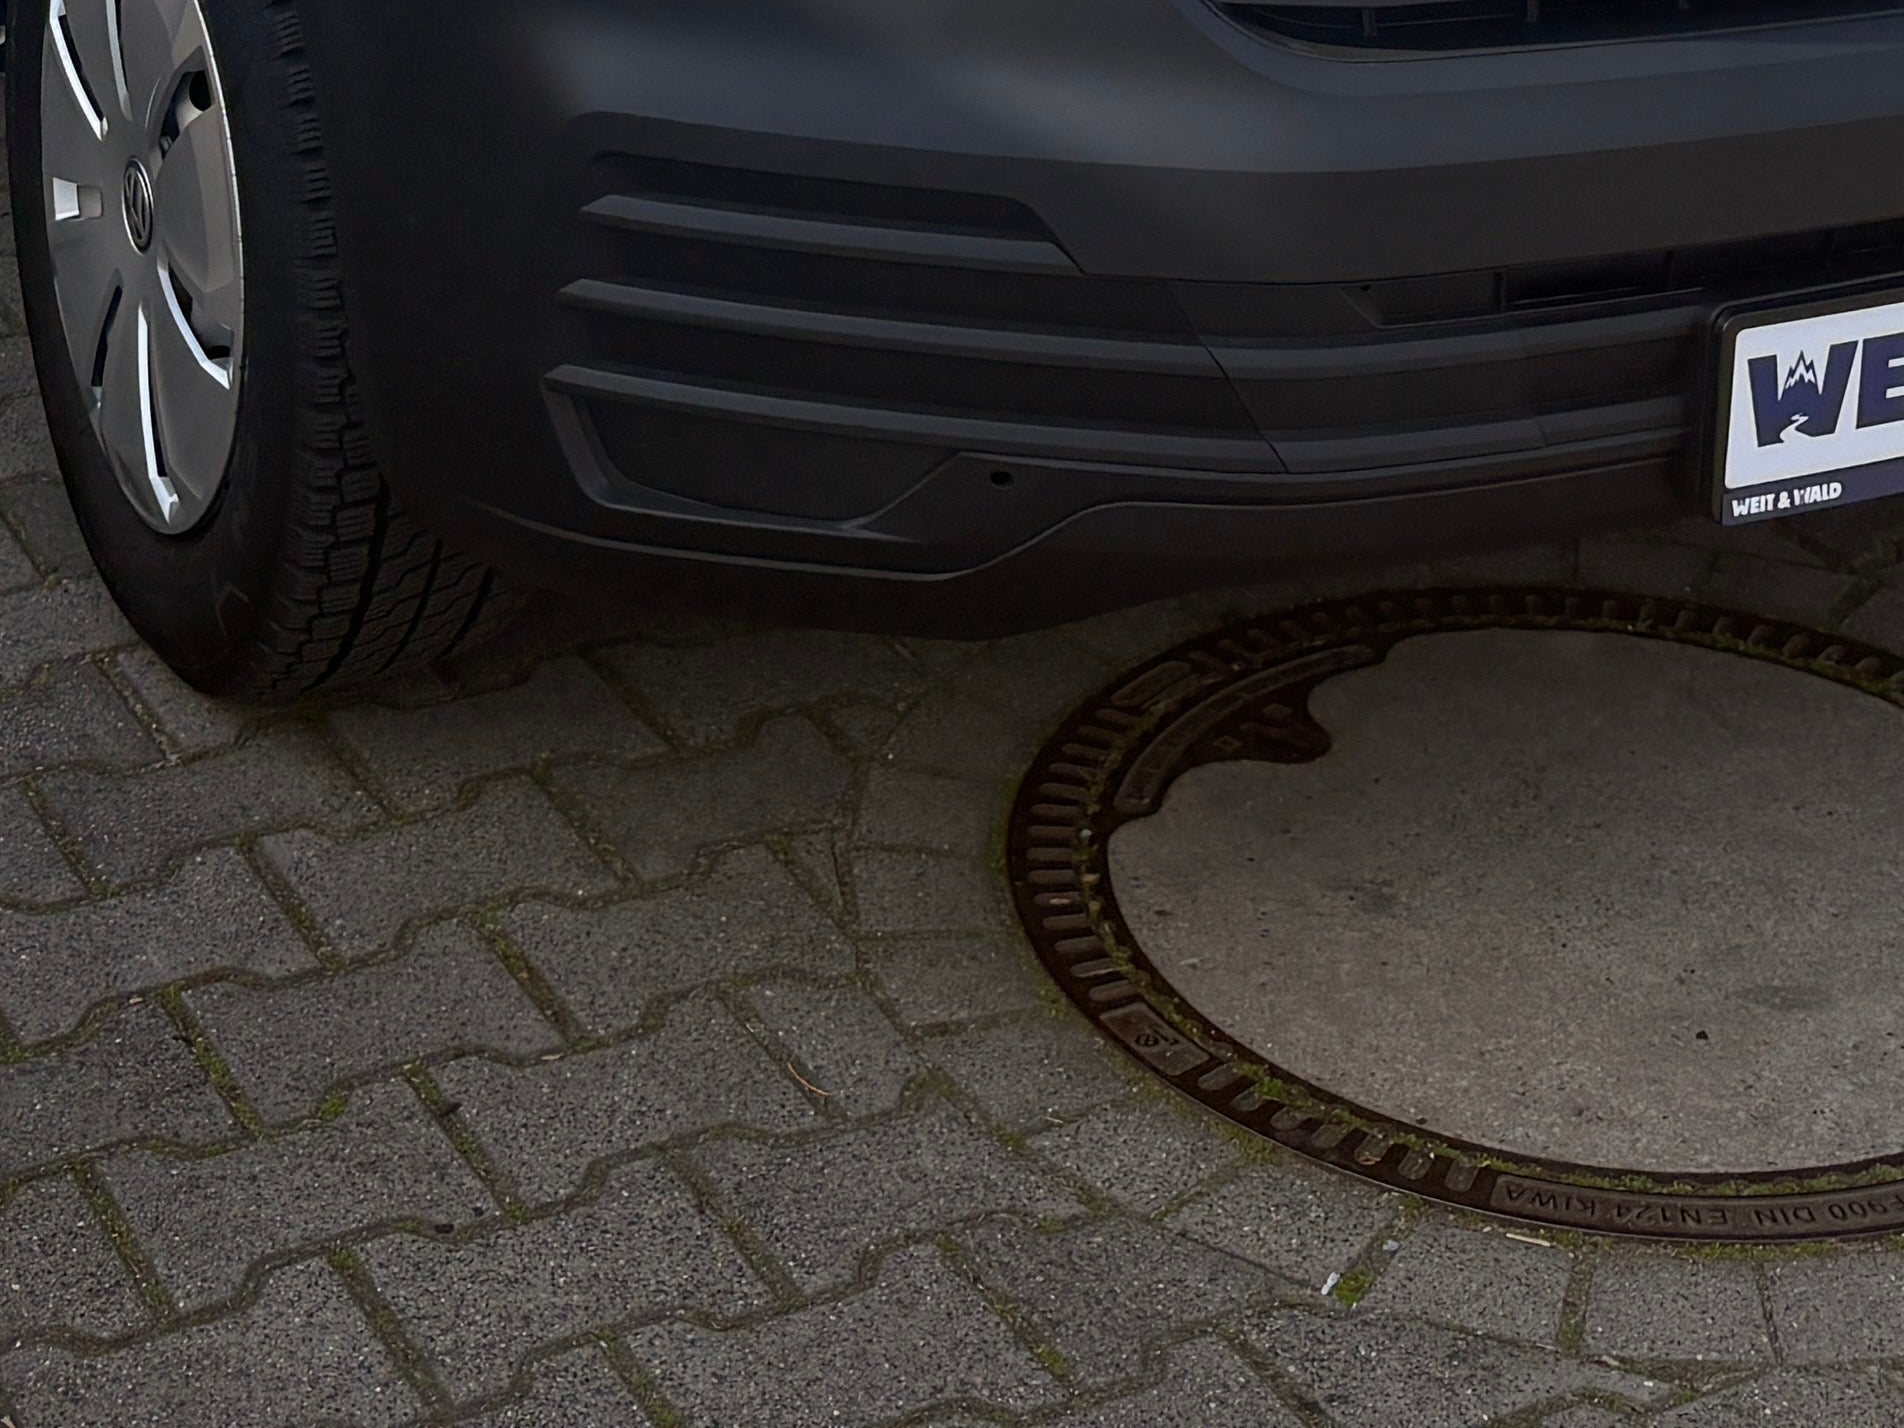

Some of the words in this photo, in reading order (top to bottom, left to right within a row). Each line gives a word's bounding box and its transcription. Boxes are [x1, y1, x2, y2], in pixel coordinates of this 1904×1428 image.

[1731, 493, 1776, 518] WEIT
[1777, 490, 1791, 510] &
[1792, 481, 1843, 506] WALD
[1504, 1185, 1596, 1218] KIWA
[1752, 1204, 1817, 1227] DIN
